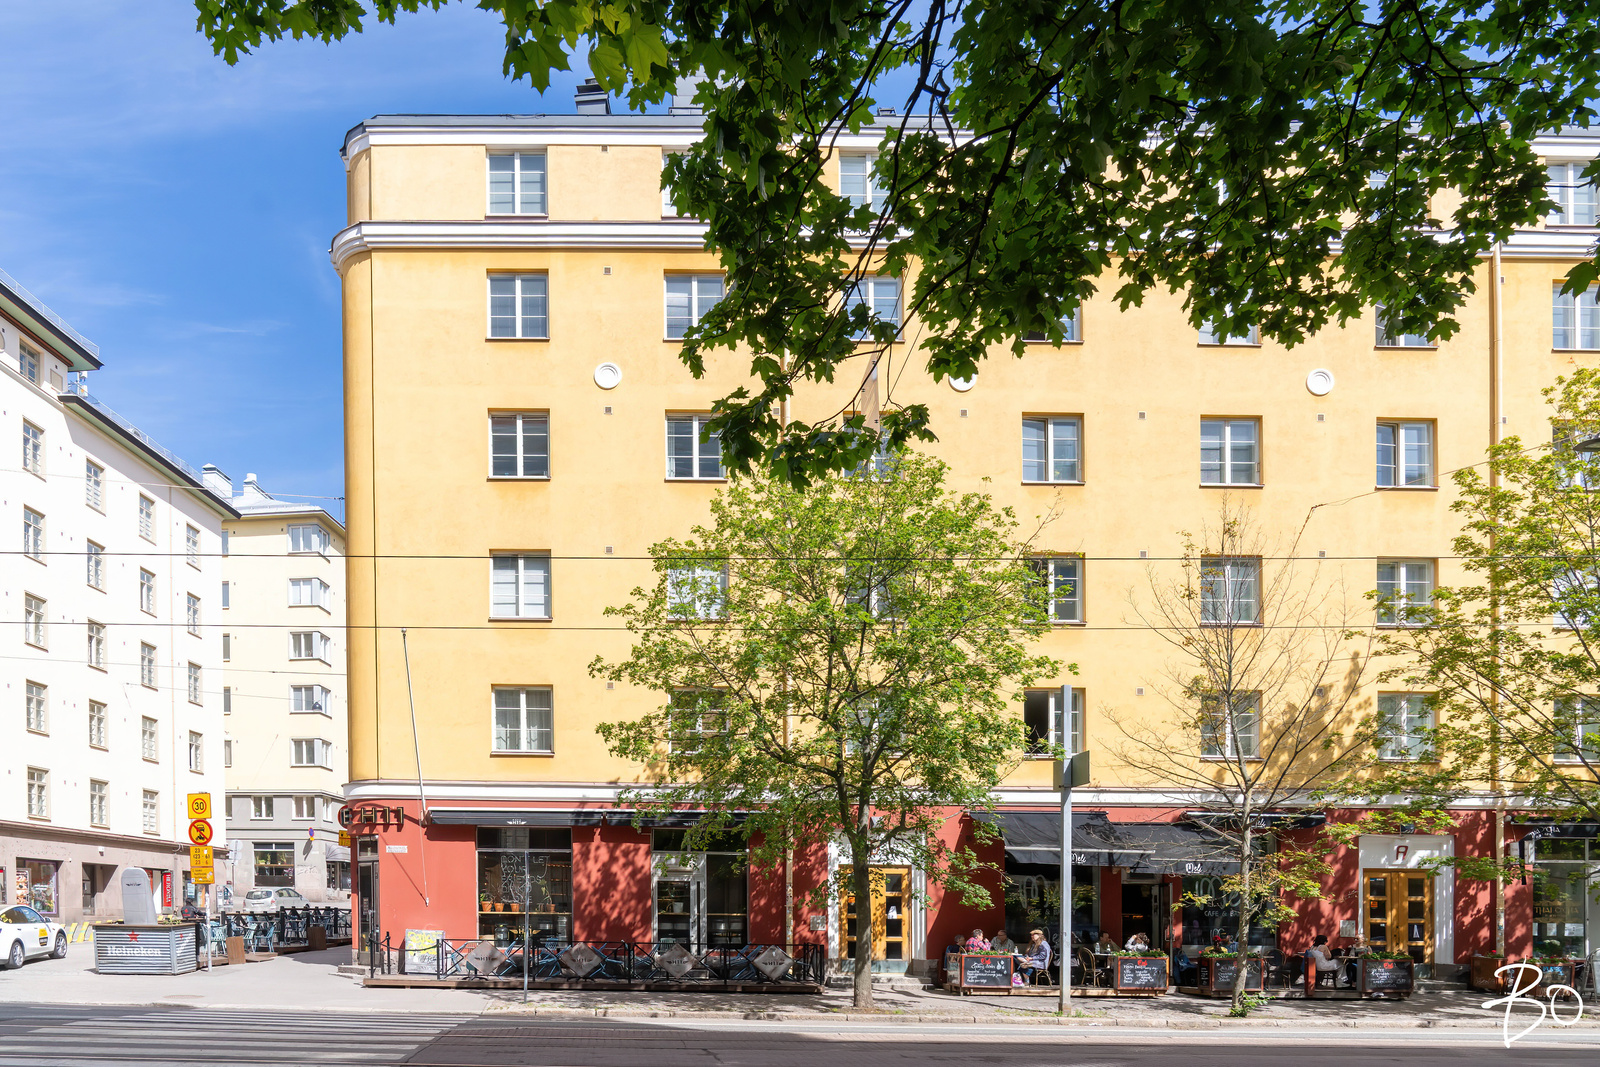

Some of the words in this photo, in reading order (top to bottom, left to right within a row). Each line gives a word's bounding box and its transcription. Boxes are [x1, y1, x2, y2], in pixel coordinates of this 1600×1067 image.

[194, 801, 205, 811] 30
[1185, 862, 1203, 874] Meli
[106, 944, 161, 956] Heineken
